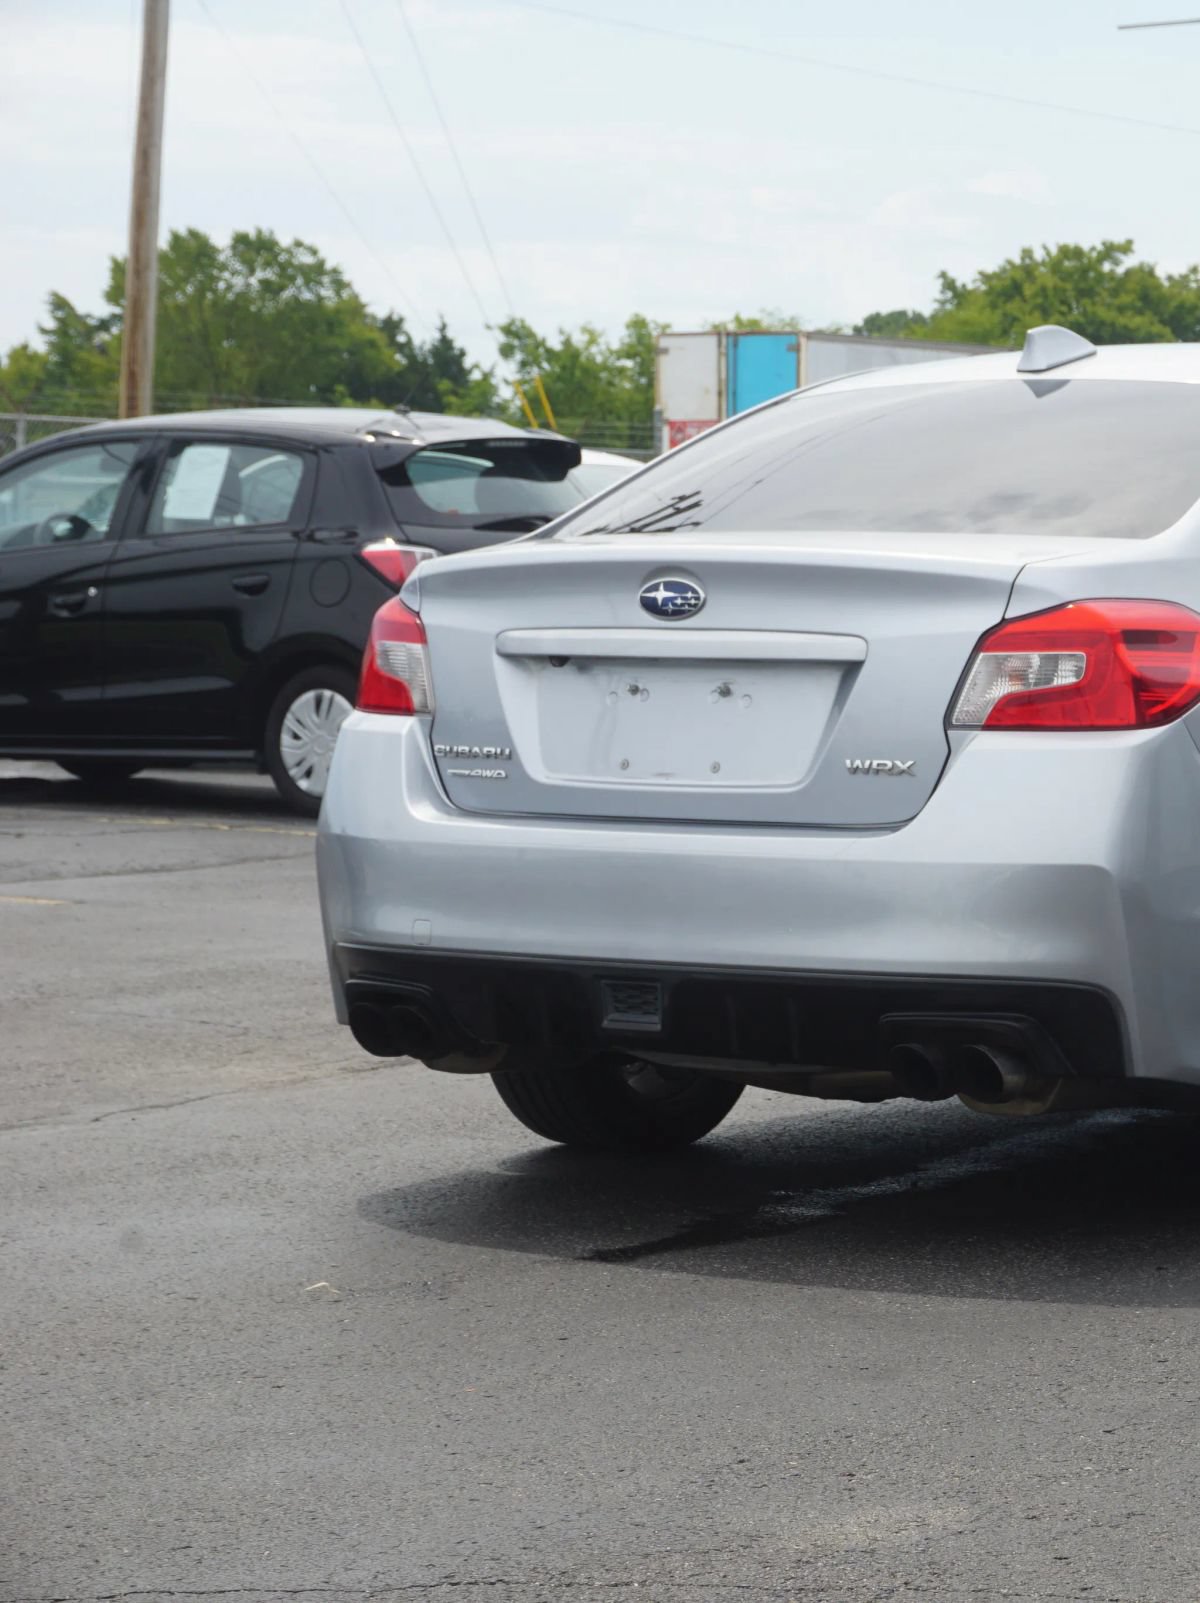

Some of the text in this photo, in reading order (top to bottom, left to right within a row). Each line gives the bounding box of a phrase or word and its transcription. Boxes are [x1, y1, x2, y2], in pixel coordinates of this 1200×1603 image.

[434, 745, 512, 760] SUBARU
[469, 769, 507, 778] AWD
[845, 759, 916, 776] WRX
